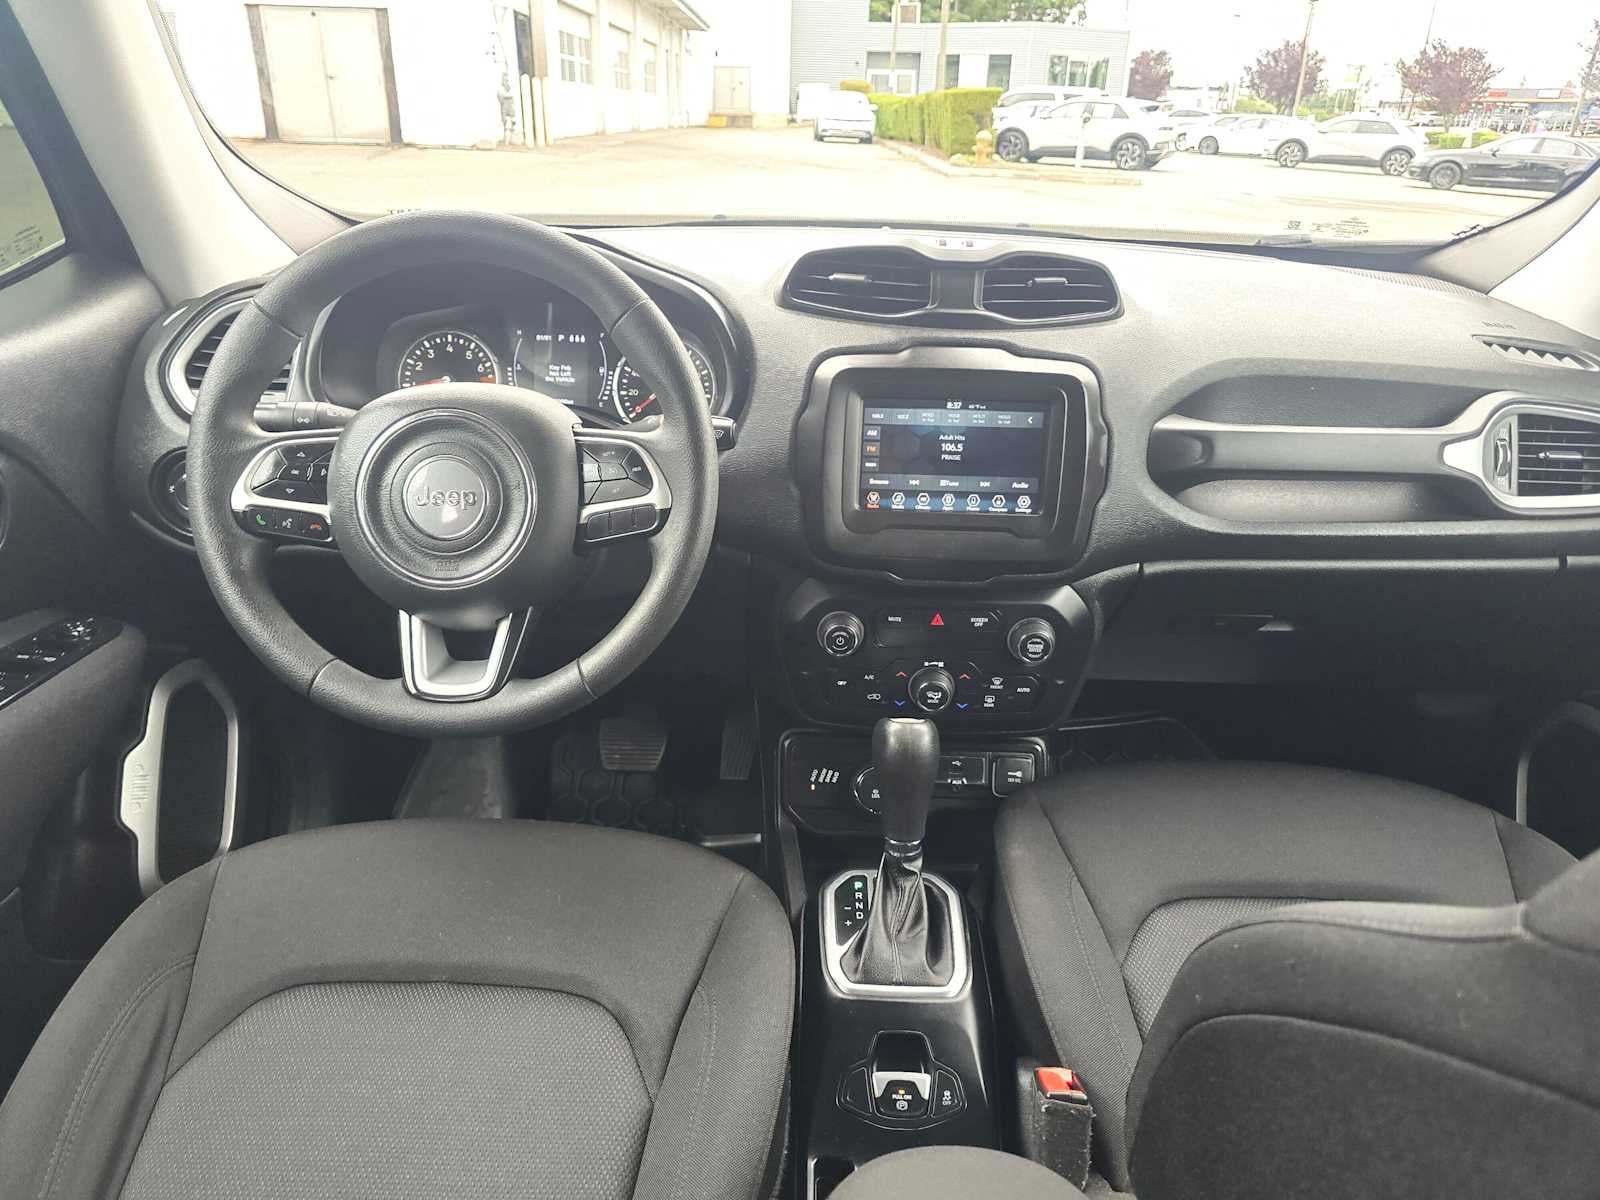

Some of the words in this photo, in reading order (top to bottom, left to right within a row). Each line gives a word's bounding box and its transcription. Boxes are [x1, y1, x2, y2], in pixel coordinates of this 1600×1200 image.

[446, 344, 454, 353] 4
[427, 349, 435, 359] 3
[465, 350, 473, 360] 5
[415, 362, 424, 371] 2
[628, 388, 640, 396] 20
[866, 445, 877, 453] FM
[941, 443, 964, 452] 106.5
[415, 486, 477, 510] Jeep
[854, 881, 864, 890] P
[855, 892, 863, 900] R
[855, 902, 864, 910] N
[855, 911, 864, 920] D
